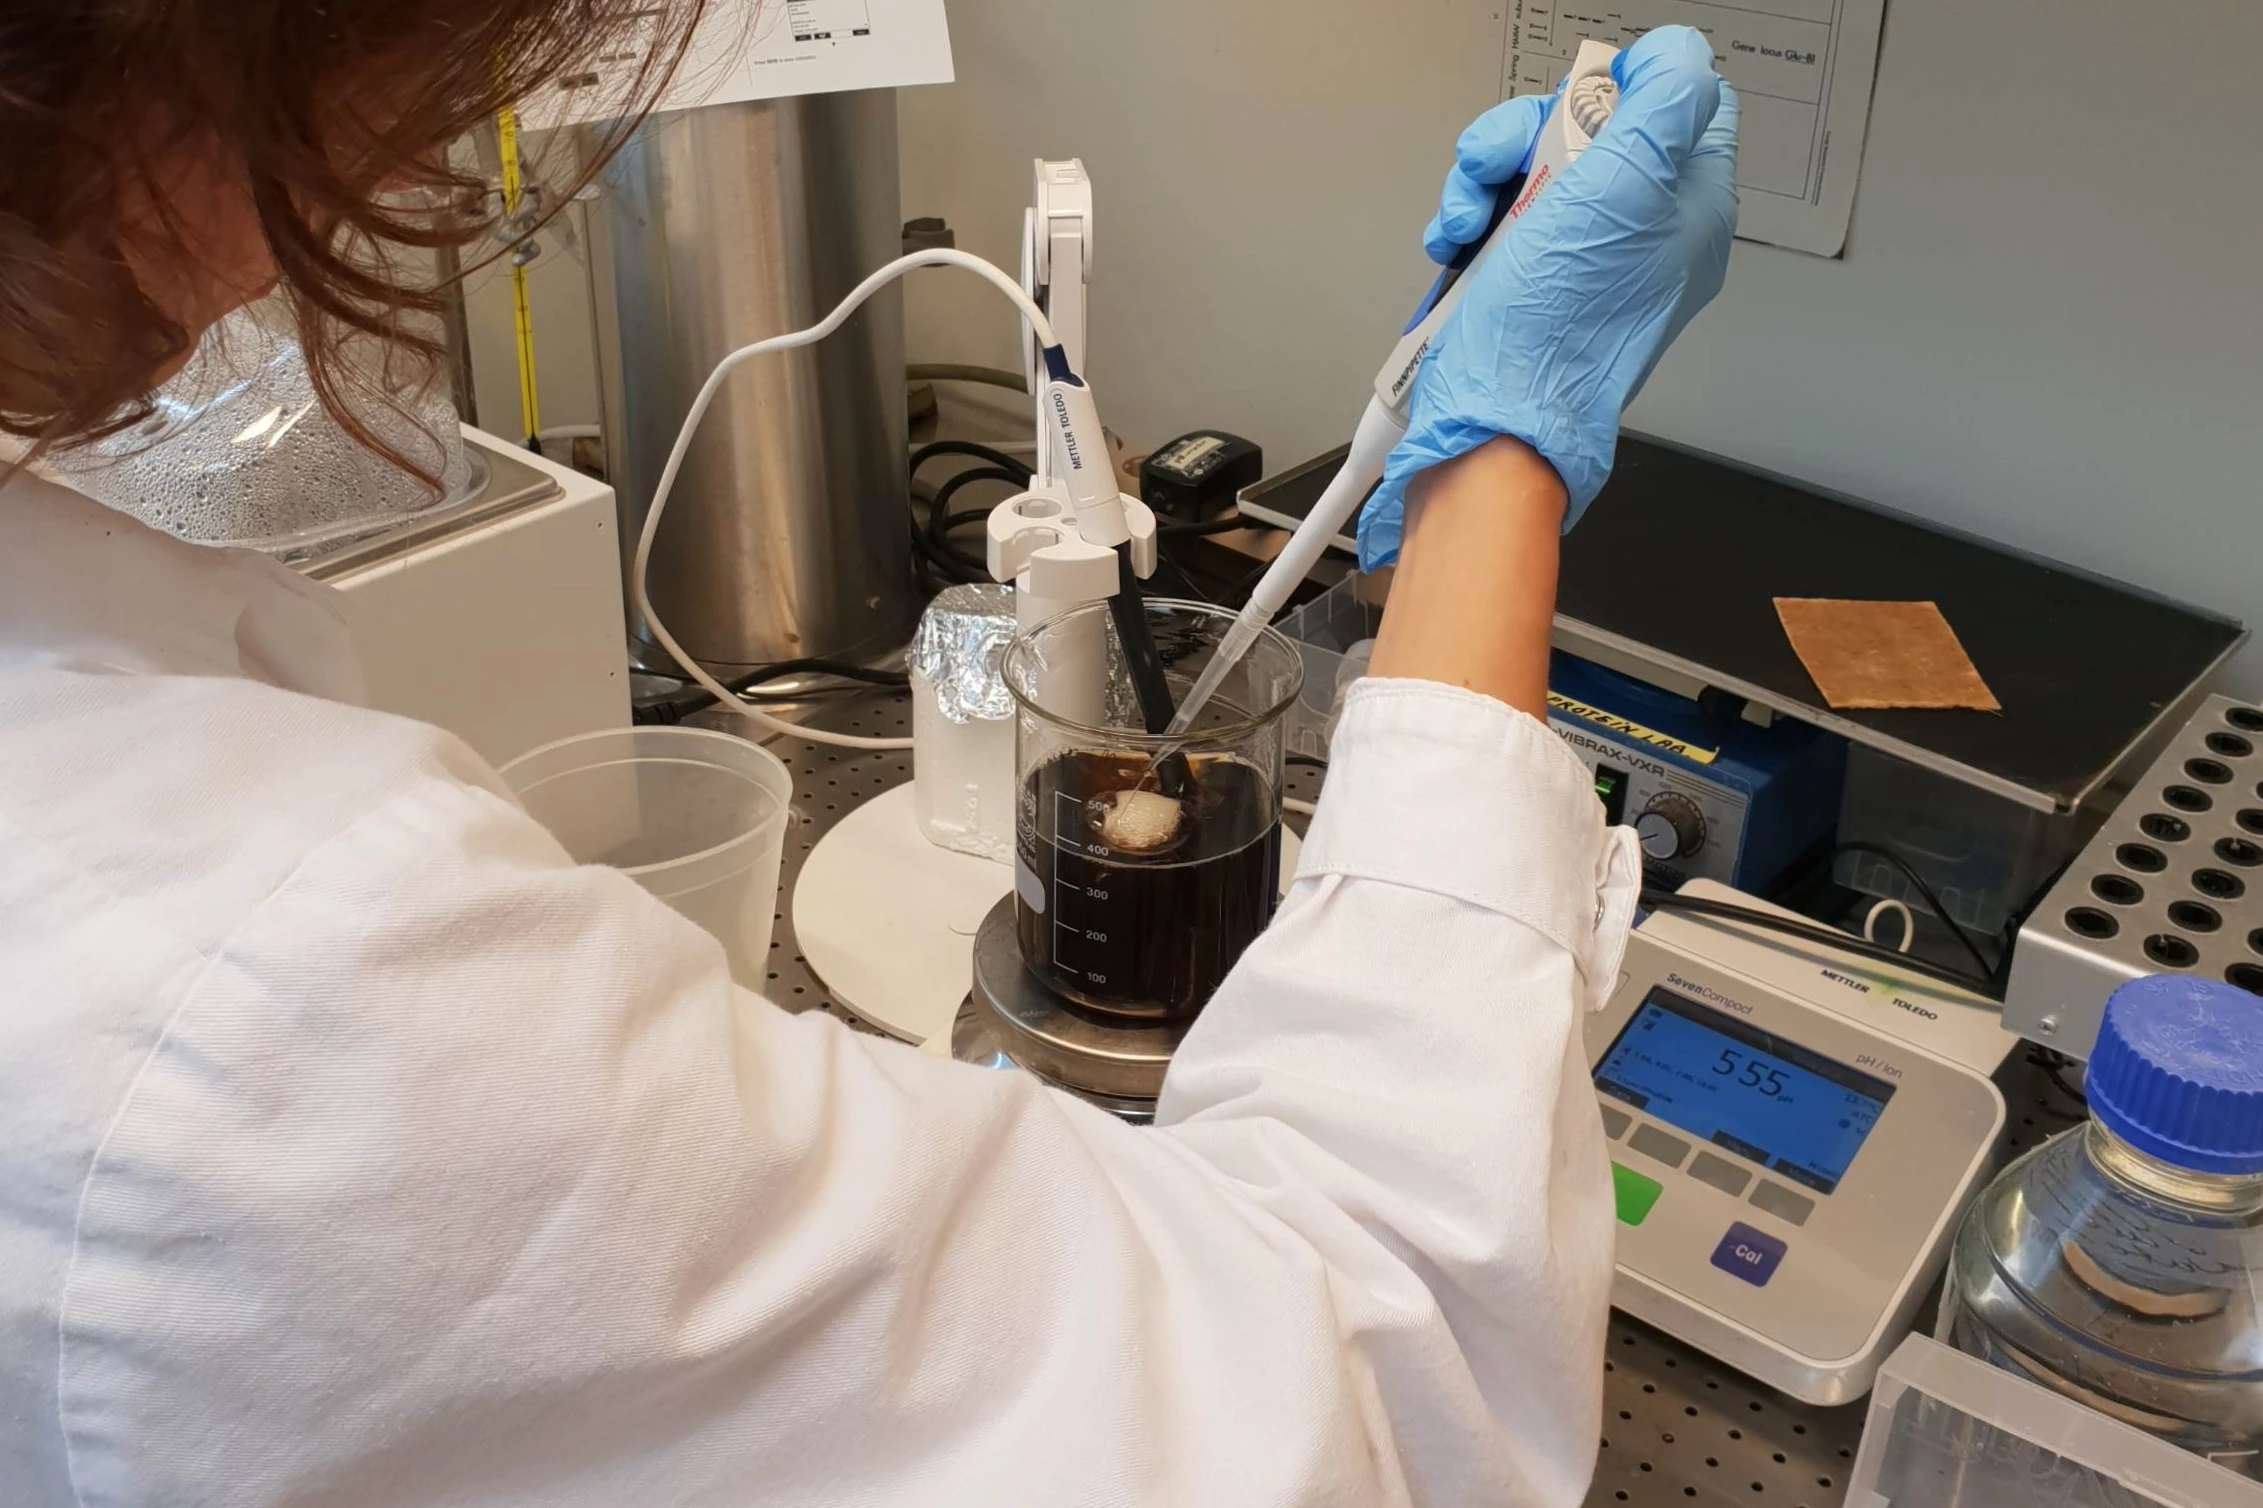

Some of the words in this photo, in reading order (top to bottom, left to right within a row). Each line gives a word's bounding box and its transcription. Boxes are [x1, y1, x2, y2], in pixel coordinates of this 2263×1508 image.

[1731, 40, 1756, 53] Gene
[1510, 164, 1549, 218] Thermo
[1392, 338, 1429, 397] FINNPIPETTE
[1053, 393, 1071, 428] TOLEDO
[1064, 431, 1083, 470] METTLER
[1548, 696, 1639, 733] PROTEIN
[1087, 844, 1109, 857] 400
[1086, 887, 1109, 901] 300
[1085, 930, 1108, 943] 200
[1086, 972, 1107, 984] 100
[1667, 973, 1754, 1015] SevenCompact
[1820, 970, 1870, 993] METTLER
[1892, 997, 1938, 1021] TOLEDO
[1735, 1244, 1763, 1265] Cal
